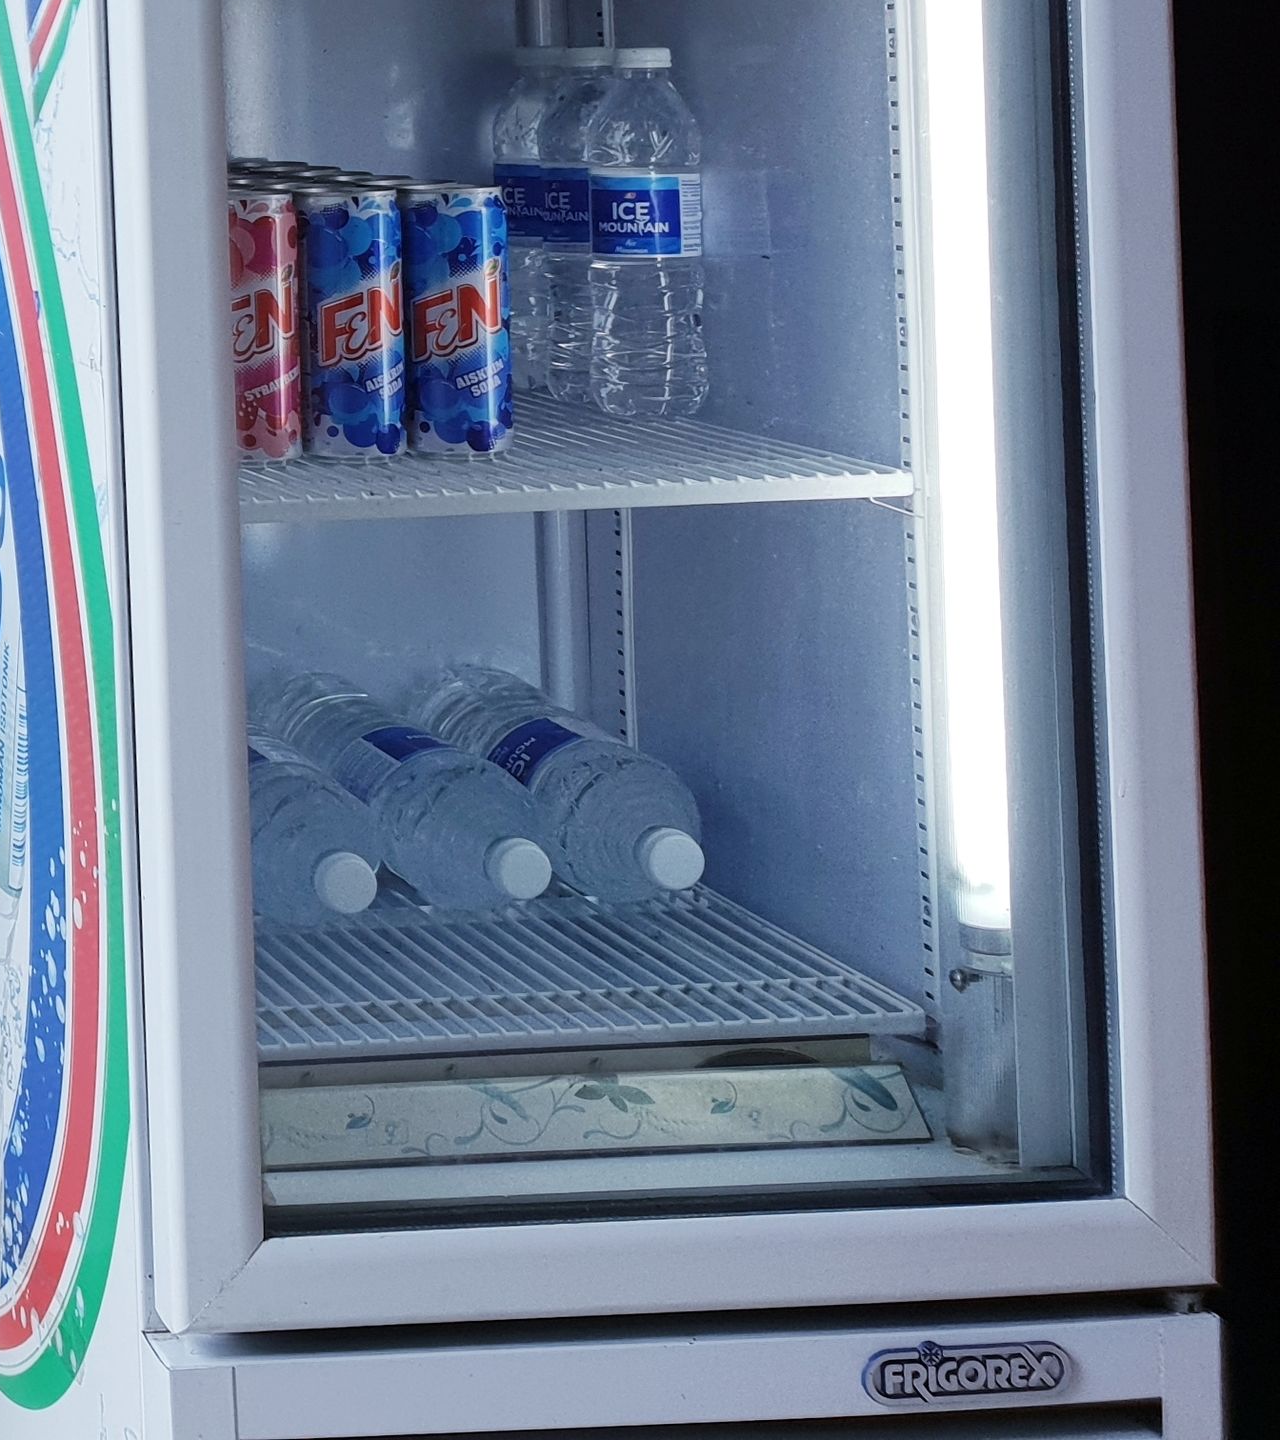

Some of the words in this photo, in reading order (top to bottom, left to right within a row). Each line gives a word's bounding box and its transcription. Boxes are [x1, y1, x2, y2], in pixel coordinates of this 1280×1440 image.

[598, 219, 670, 235] MOUNTAIN
[612, 201, 651, 221] ICE
[321, 280, 402, 364] F&N
[412, 277, 502, 363] F&N
[883, 1354, 1057, 1402] FRIGOREX
